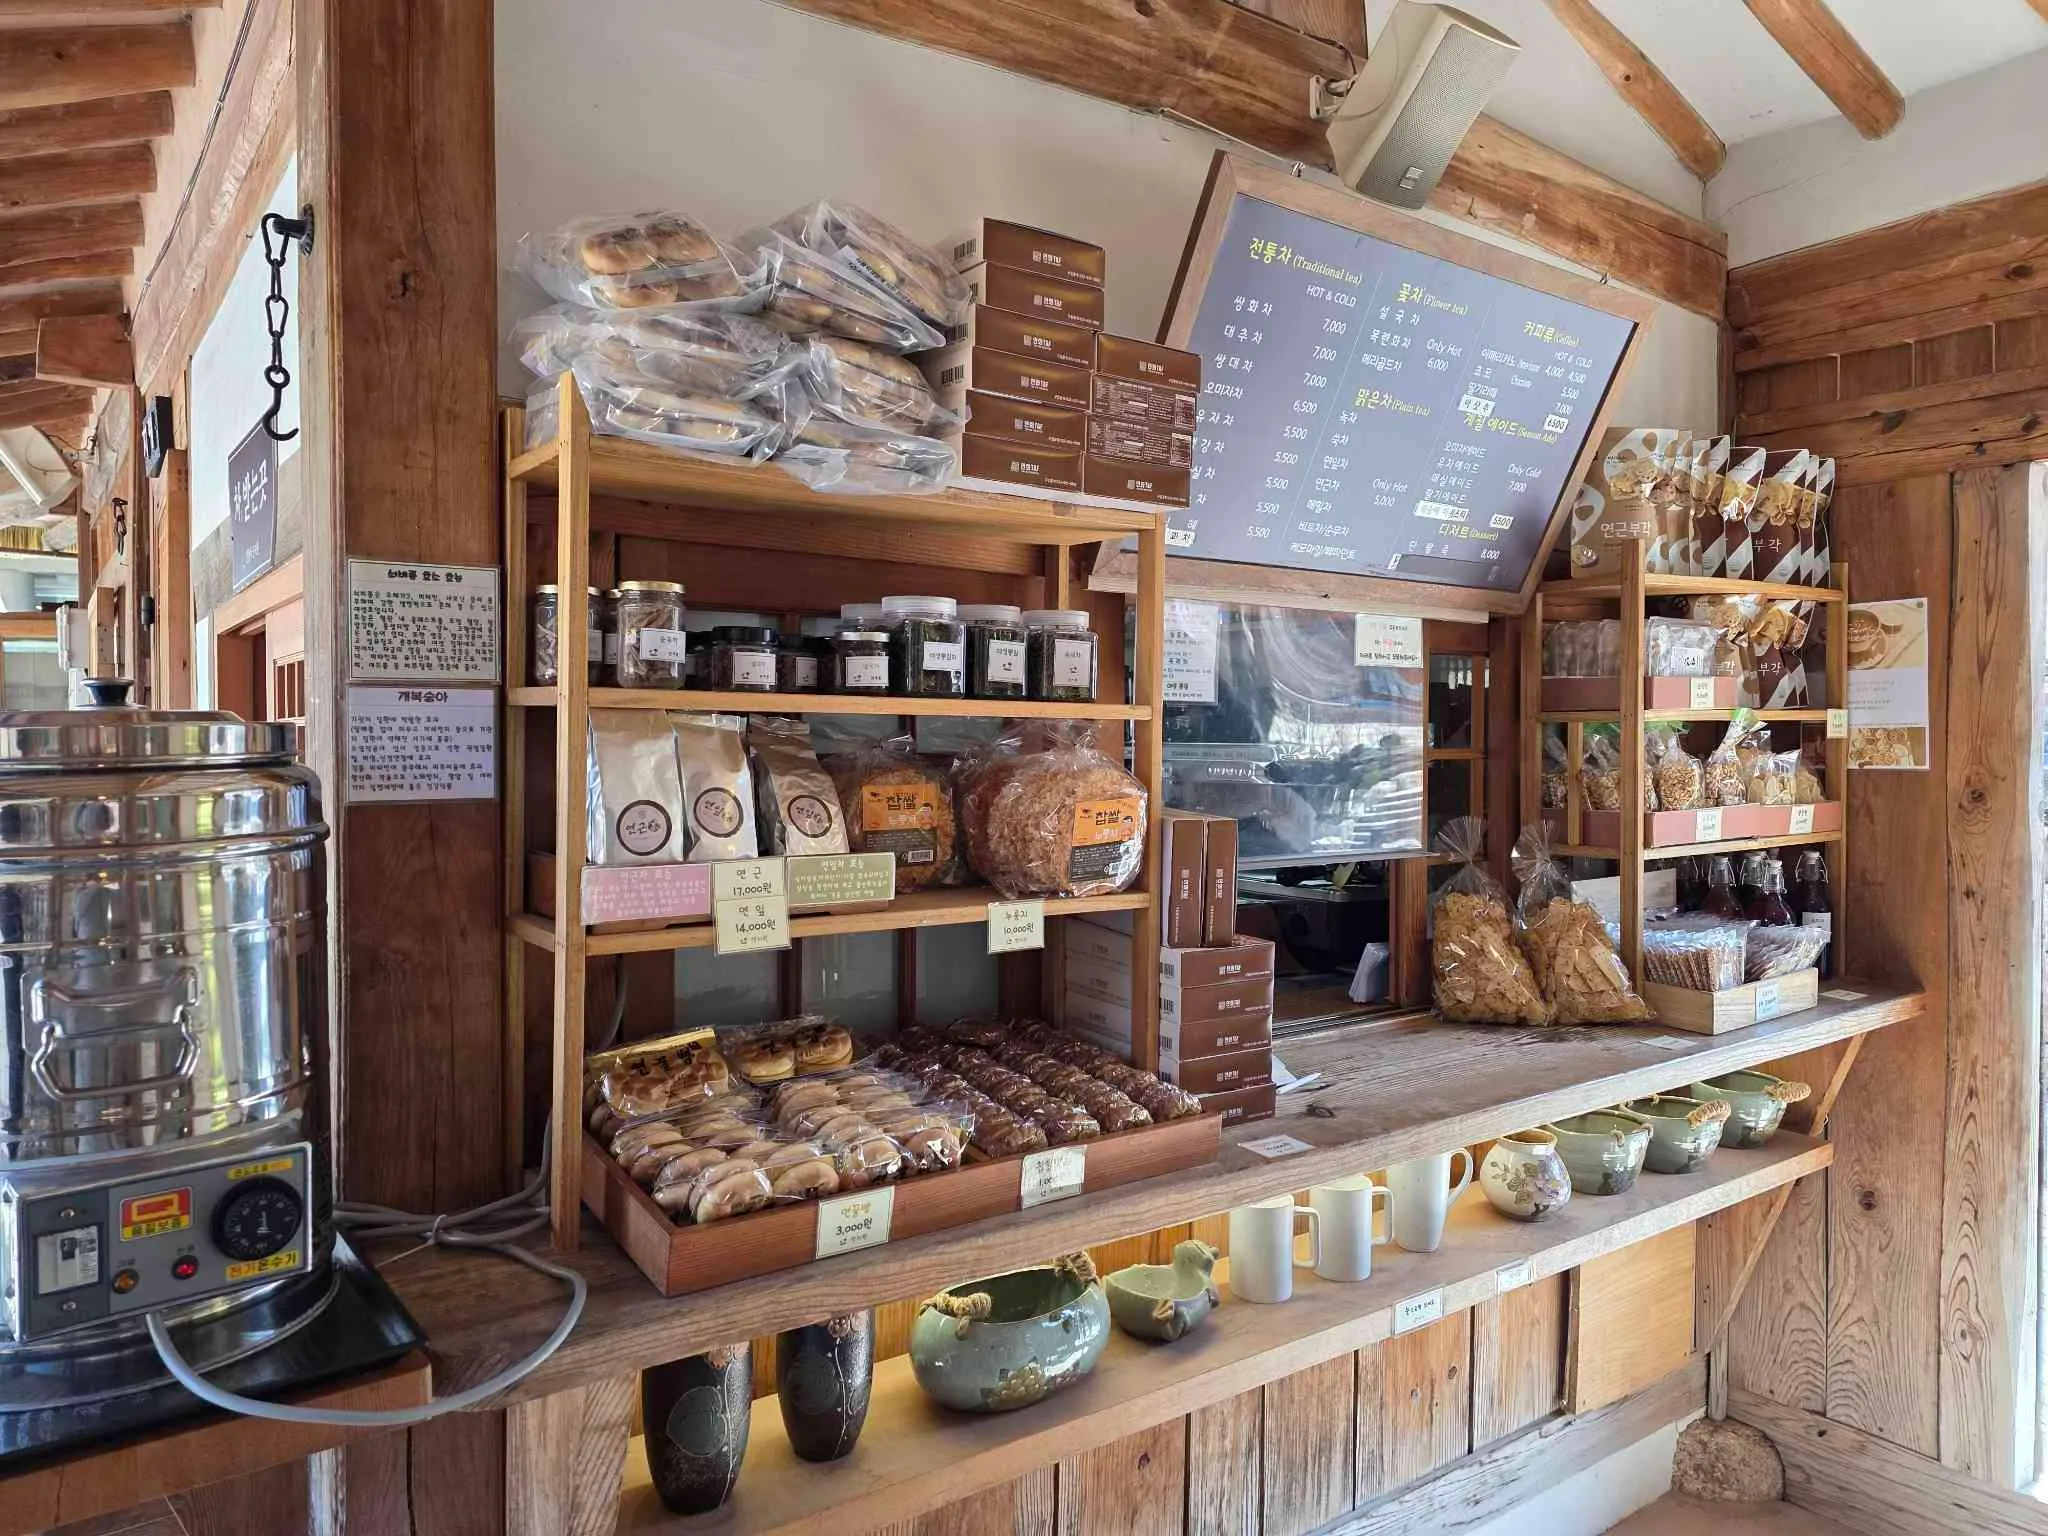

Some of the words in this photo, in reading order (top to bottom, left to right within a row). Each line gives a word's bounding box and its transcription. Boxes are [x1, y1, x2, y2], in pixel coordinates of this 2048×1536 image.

[1249, 237, 1292, 264] 전통차
[1293, 254, 1345, 280] (Traditional
[1345, 272, 1363, 287] tea)
[1306, 285, 1324, 299] HOT
[1334, 292, 1357, 308] COLD
[1322, 318, 1346, 335] 7,000
[1523, 321, 1555, 343] 커피류
[1313, 346, 1336, 361] 7,000
[1427, 339, 1446, 355] Only
[1447, 343, 1462, 357] Hot
[1427, 358, 1448, 371] 6,000
[1303, 373, 1327, 388] 7,000
[1545, 366, 1564, 378] 4,000
[1568, 371, 1586, 384] 4,500
[1204, 382, 1243, 400] 오미자차
[1355, 389, 1392, 409] 맑은차
[1293, 400, 1318, 414] 6,500
[1283, 426, 1308, 440] 5,500
[1274, 451, 1298, 465] 5,500
[1265, 477, 1288, 489] 5,500
[1373, 478, 1392, 491] Only
[1393, 481, 1408, 493] Hot
[1256, 502, 1279, 514] 5,500
[1374, 495, 1395, 507] 5,000
[1247, 526, 1270, 539] 5,500
[887, 793, 916, 810] 찹쌀
[1096, 808, 1120, 825] 찹쌀
[733, 882, 772, 896] 17,000원
[735, 919, 776, 933] 14,000원
[1004, 922, 1034, 935] 10,000원
[836, 1218, 873, 1236] 3,000원
[230, 1252, 298, 1278] 전기온수기
